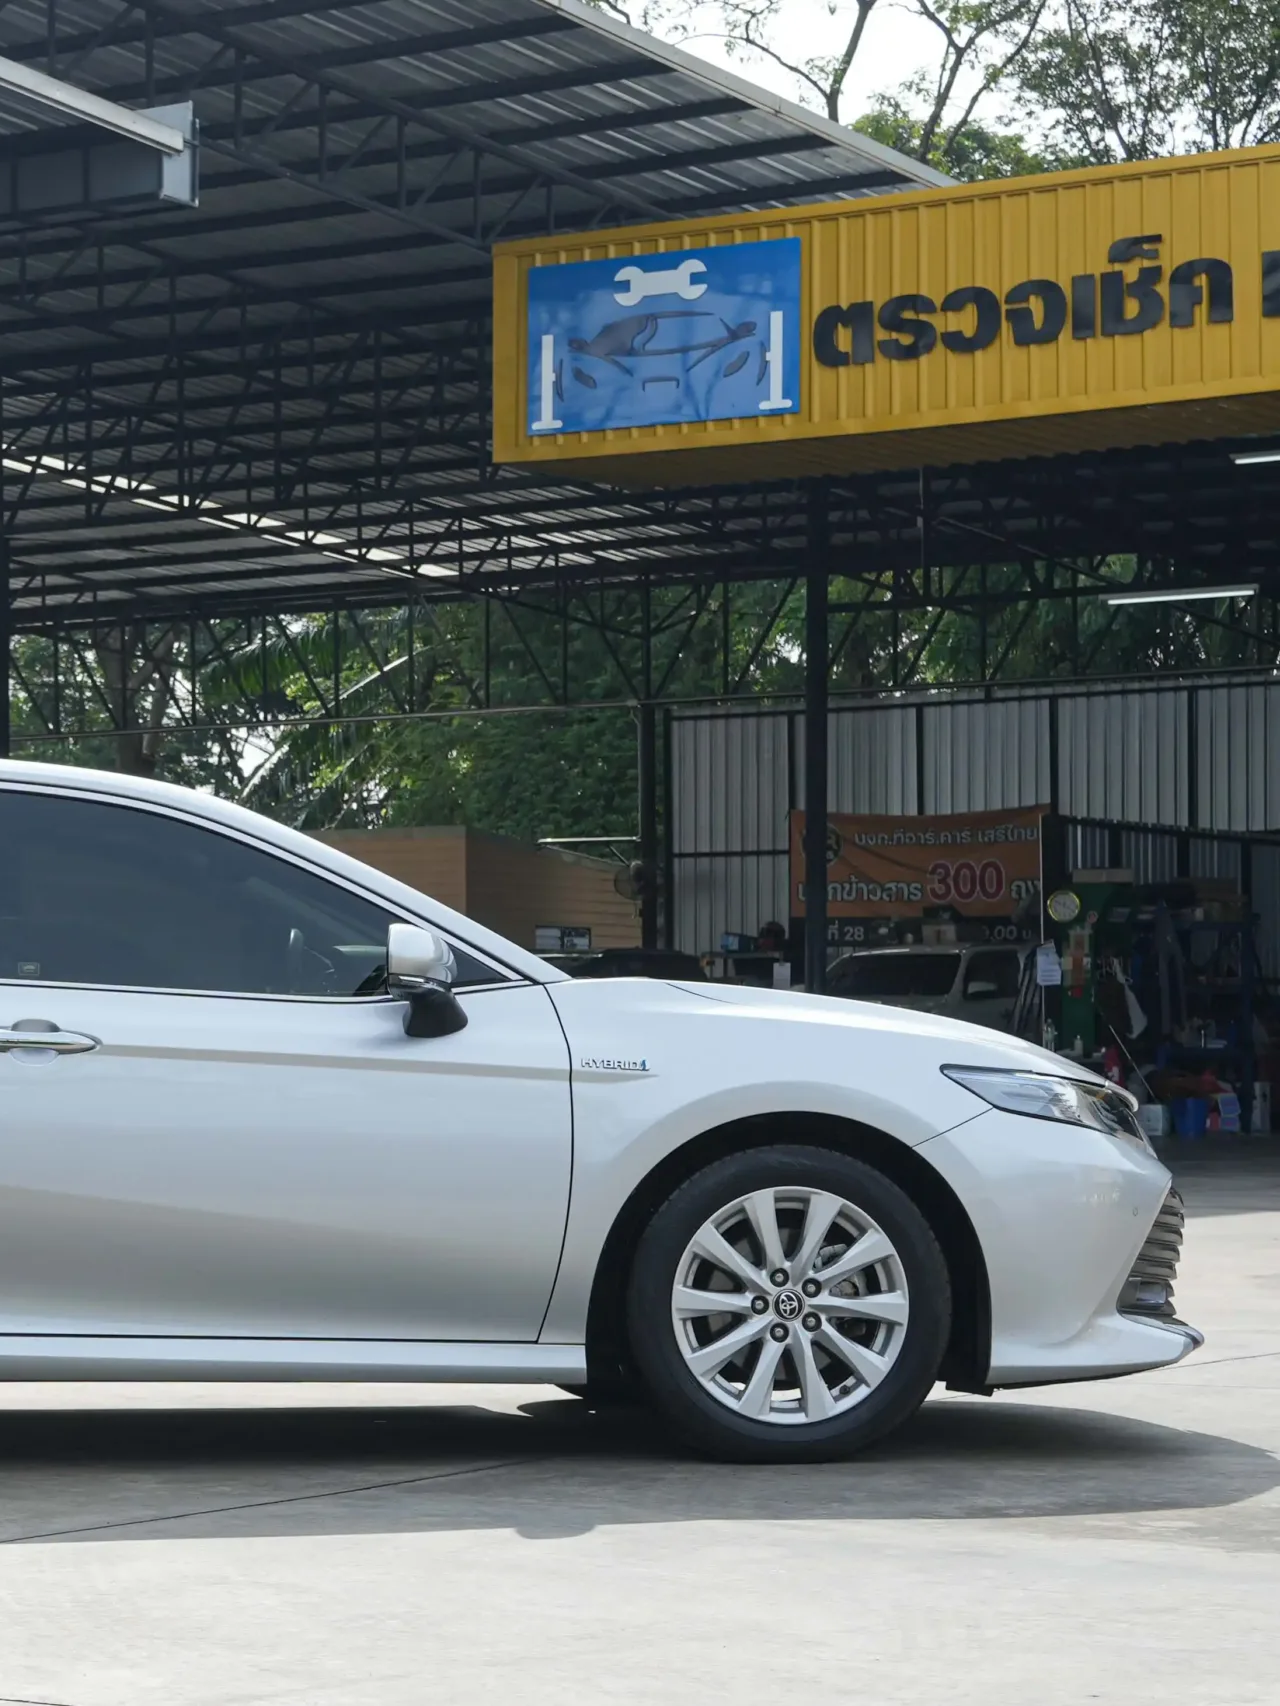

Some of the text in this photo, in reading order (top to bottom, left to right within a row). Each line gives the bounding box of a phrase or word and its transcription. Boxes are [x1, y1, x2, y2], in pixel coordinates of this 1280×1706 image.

[813, 234, 1233, 367] ตรวจเช็ค
[798, 874, 921, 902] กข้าวสาร
[926, 859, 1005, 903] 300
[844, 926, 864, 941] 28
[581, 1058, 638, 1070] HYBRID
